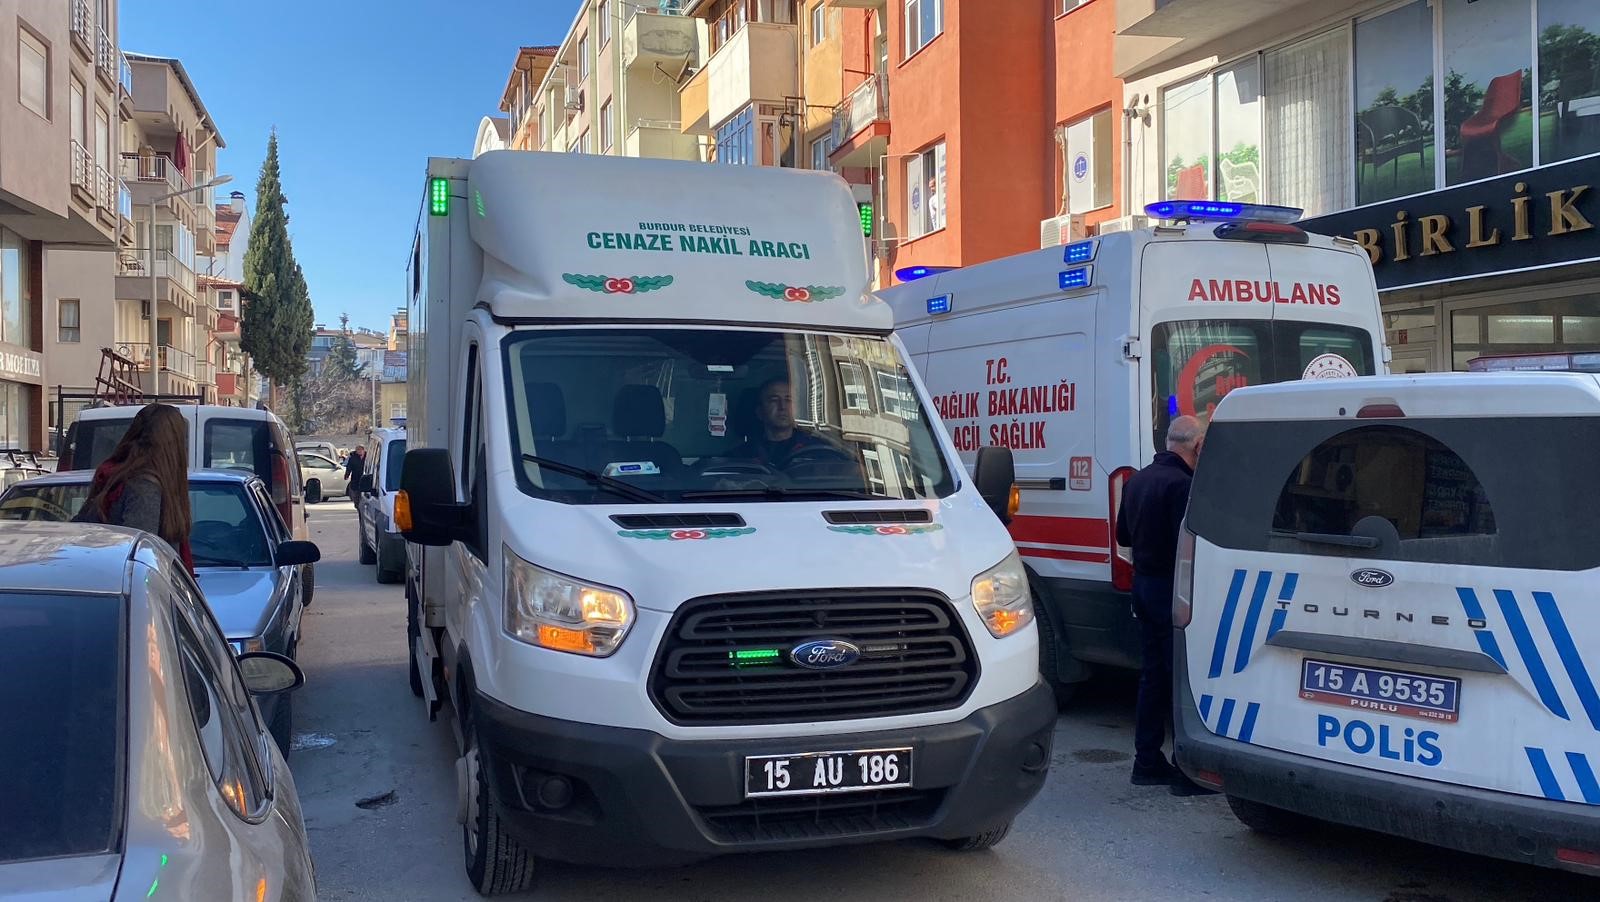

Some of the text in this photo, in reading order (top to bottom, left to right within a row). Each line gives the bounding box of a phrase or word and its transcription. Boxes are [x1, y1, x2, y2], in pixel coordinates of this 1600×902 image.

[639, 222, 751, 236] BURDUR BELEDİYESİ
[1353, 182, 1595, 265] BİRLİK
[587, 232, 810, 259] CENAZE NAKİL ARACI
[1188, 278, 1341, 306] AMBULANS
[986, 357, 1011, 385] T.C.
[988, 378, 1076, 417] BAKANLIĞI
[989, 418, 1046, 450] SAĞLIK
[1072, 460, 1089, 477] 112
[1358, 572, 1385, 585] Ford
[1277, 601, 1486, 628] TOURNEO
[807, 645, 846, 663] Ford
[1314, 667, 1446, 706] 15 A 9535
[1350, 699, 1398, 713] PURLU
[764, 754, 900, 790] 15 AU 186
